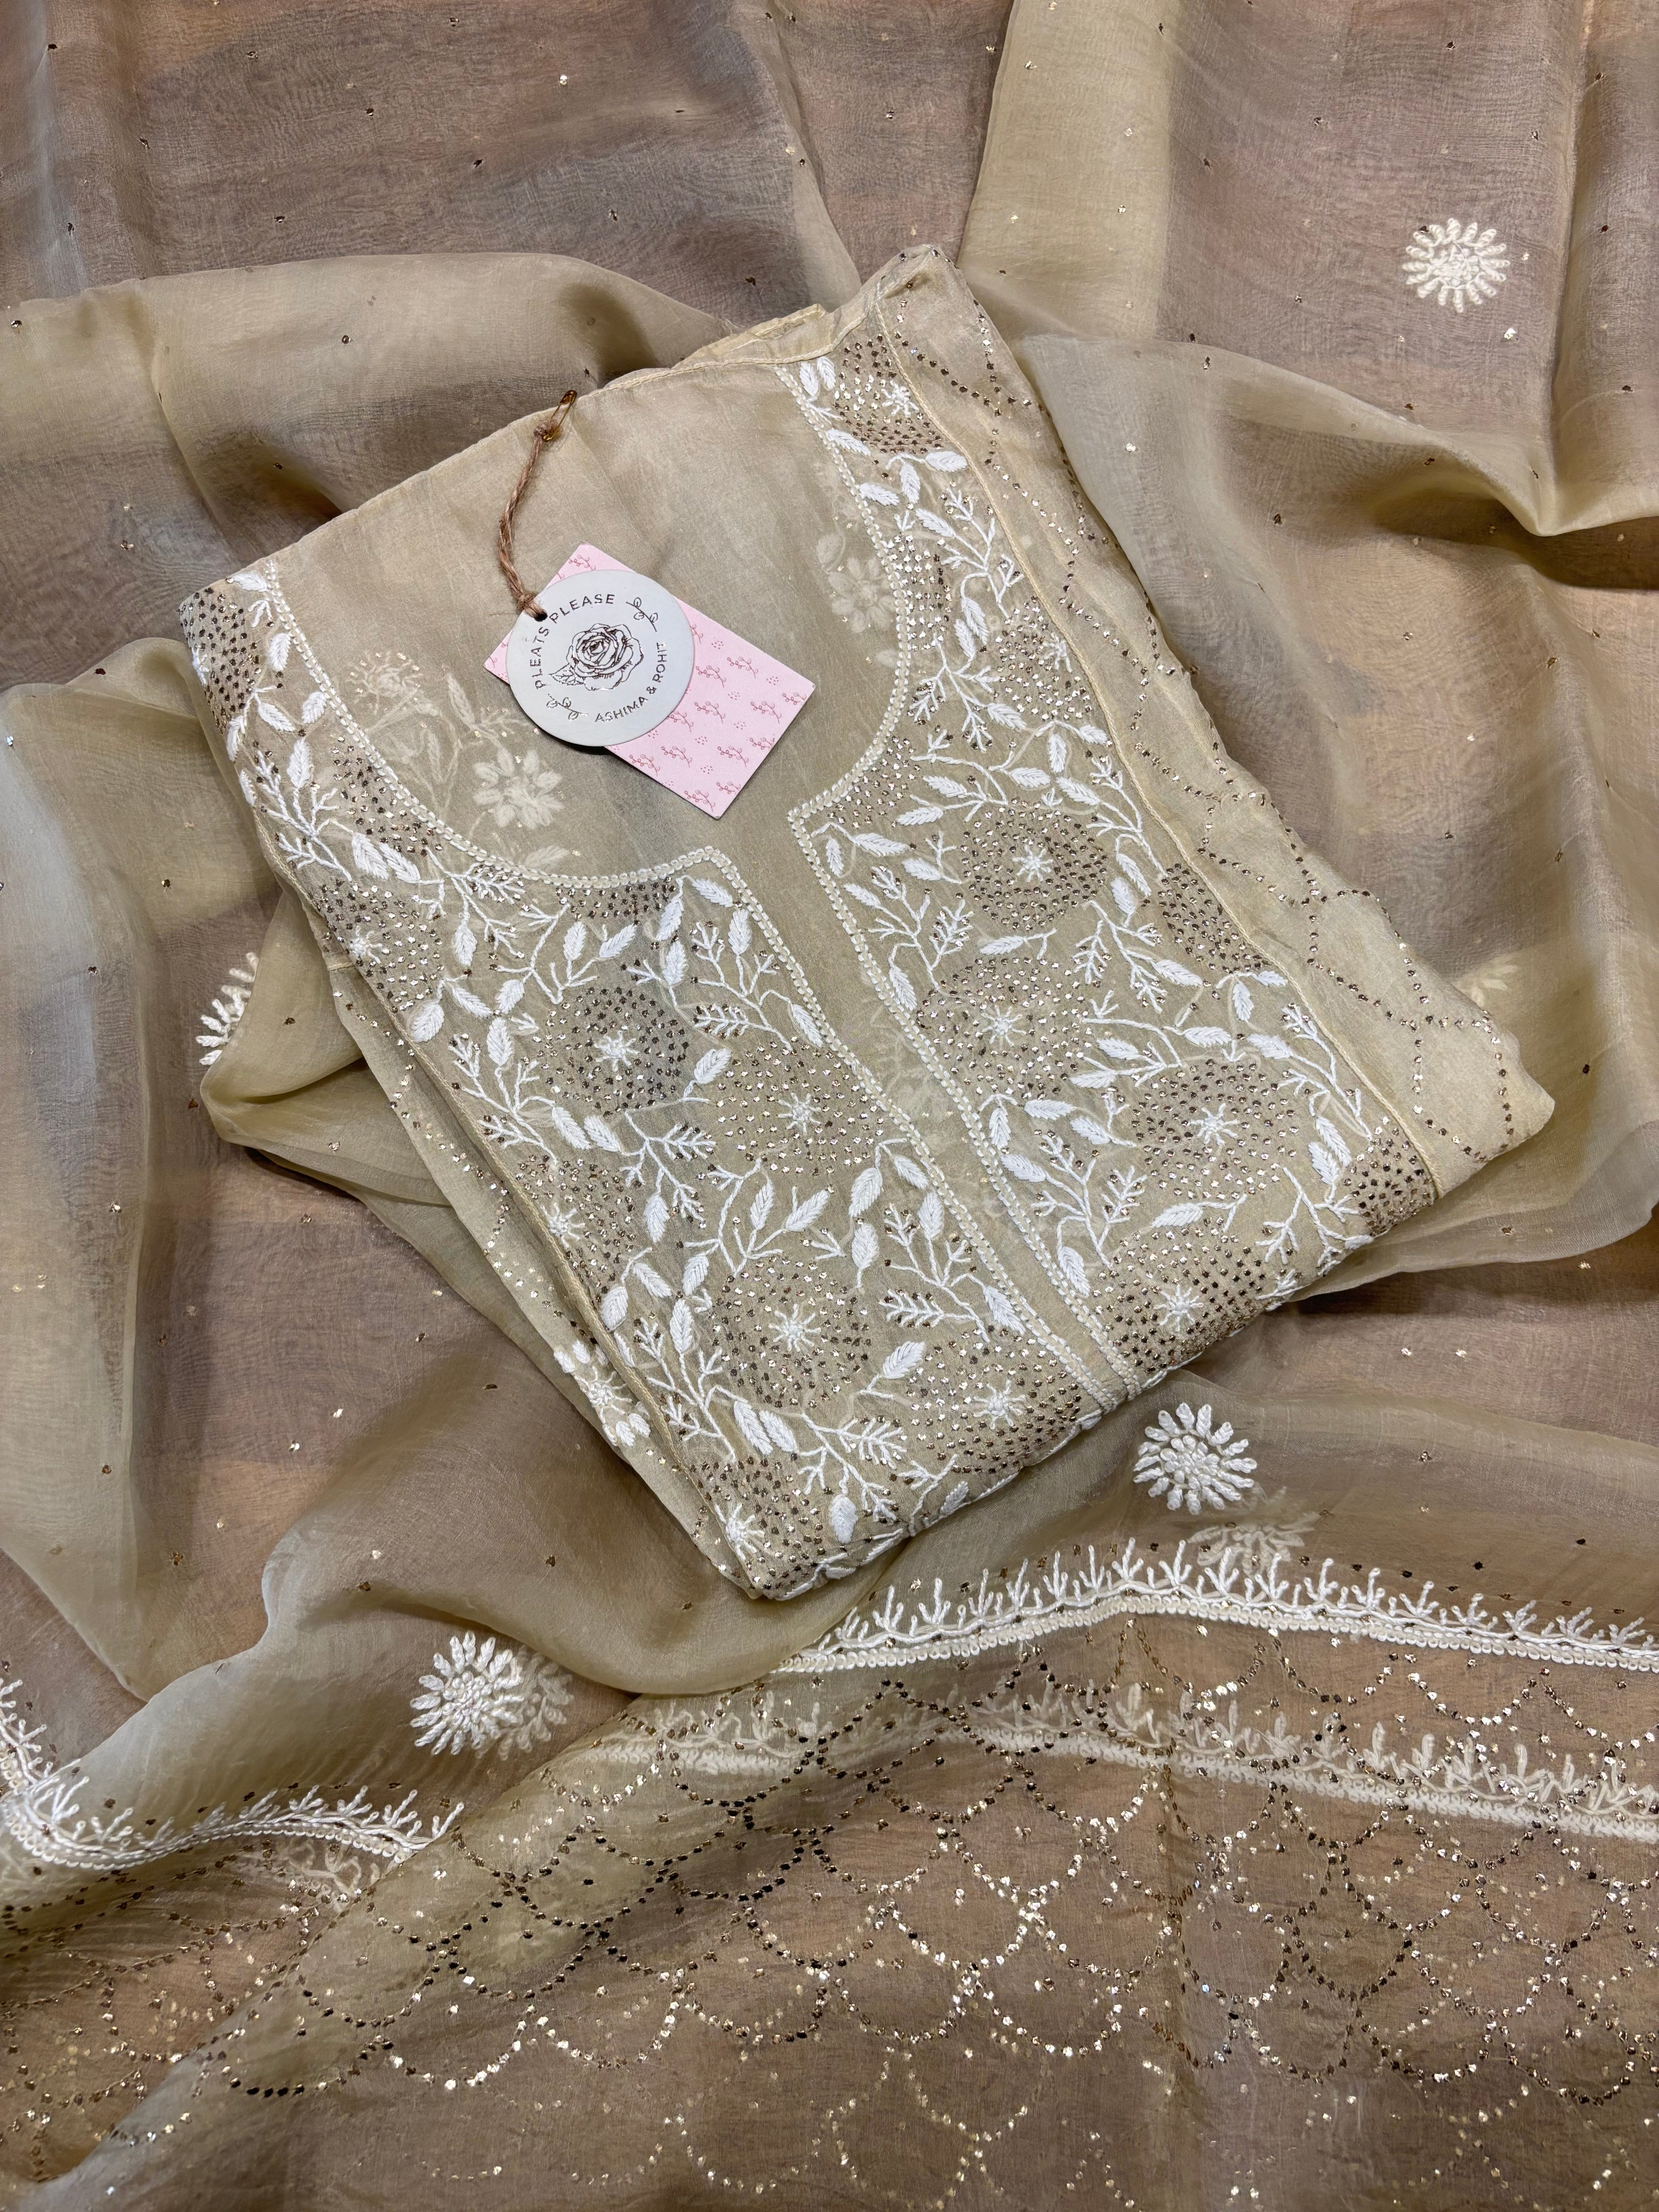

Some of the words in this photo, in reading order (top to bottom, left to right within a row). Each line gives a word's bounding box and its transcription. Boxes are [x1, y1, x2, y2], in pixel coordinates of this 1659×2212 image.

[530, 626, 550, 689] PLEATS
[549, 594, 615, 624] PLEASE
[594, 696, 649, 722] ASHIMA
[646, 686, 657, 695] &
[652, 642, 667, 683] ROHIT
